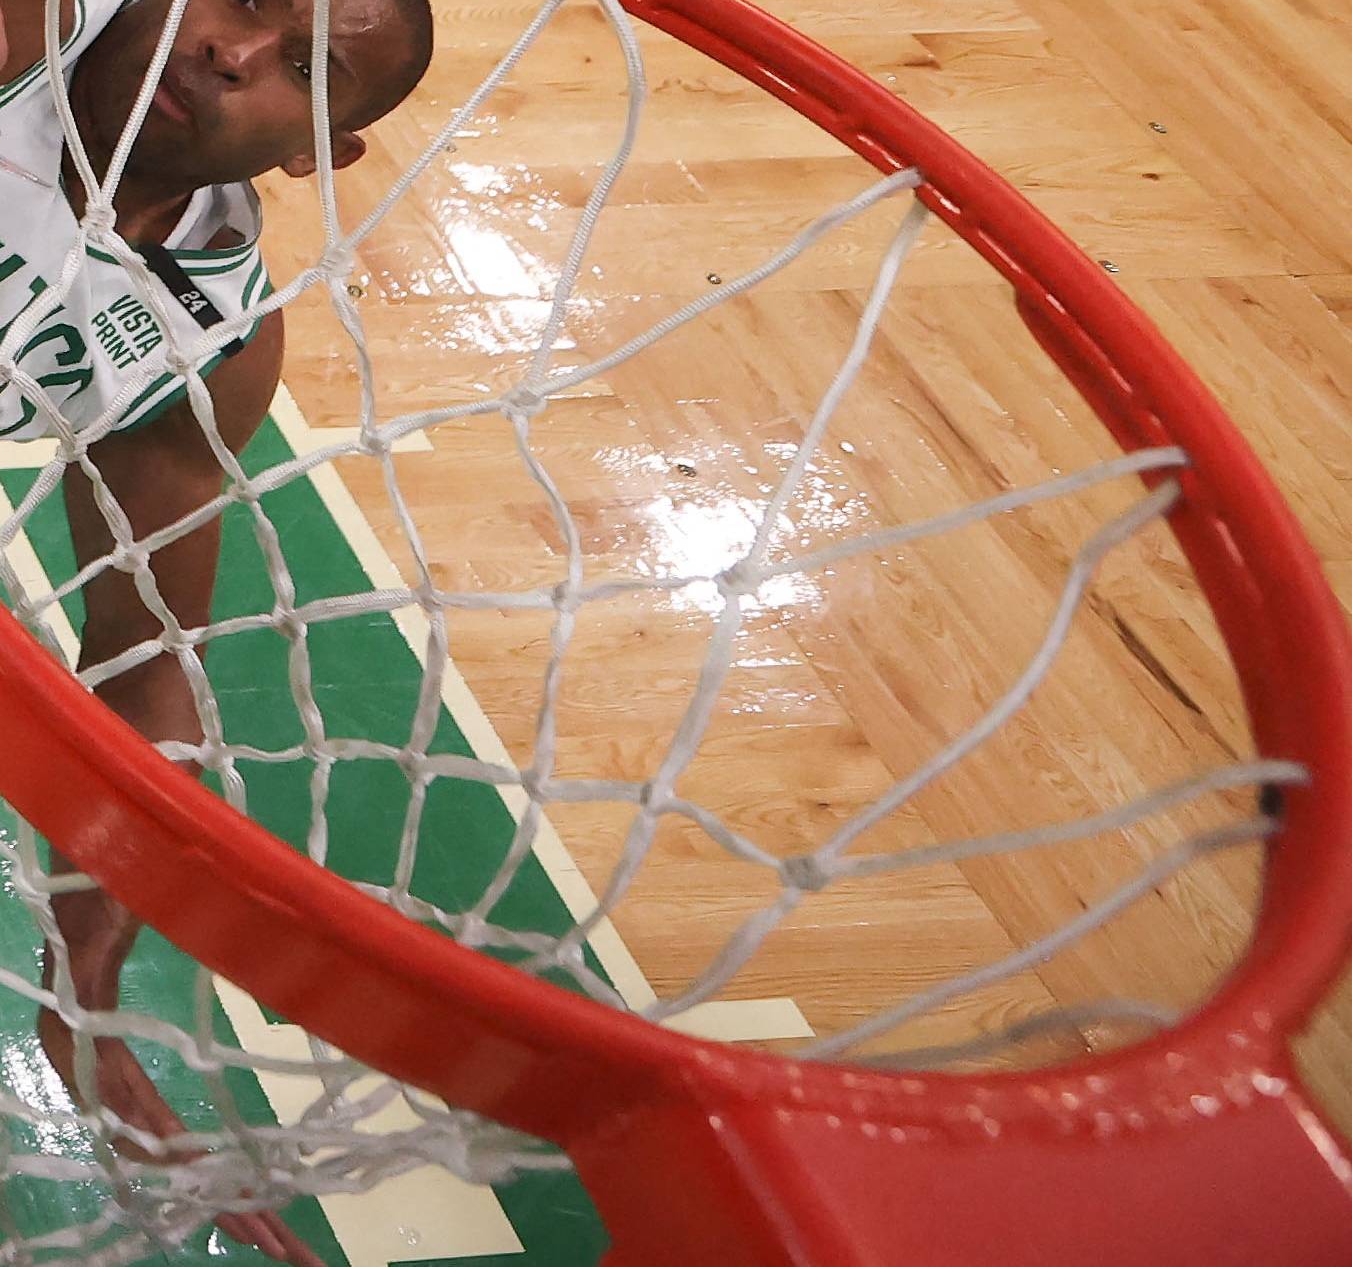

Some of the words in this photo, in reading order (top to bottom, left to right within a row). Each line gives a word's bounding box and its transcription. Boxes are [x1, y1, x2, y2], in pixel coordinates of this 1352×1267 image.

[107, 294, 164, 359] VISTA
[178, 290, 209, 315] 24
[91, 311, 138, 370] PRINT
